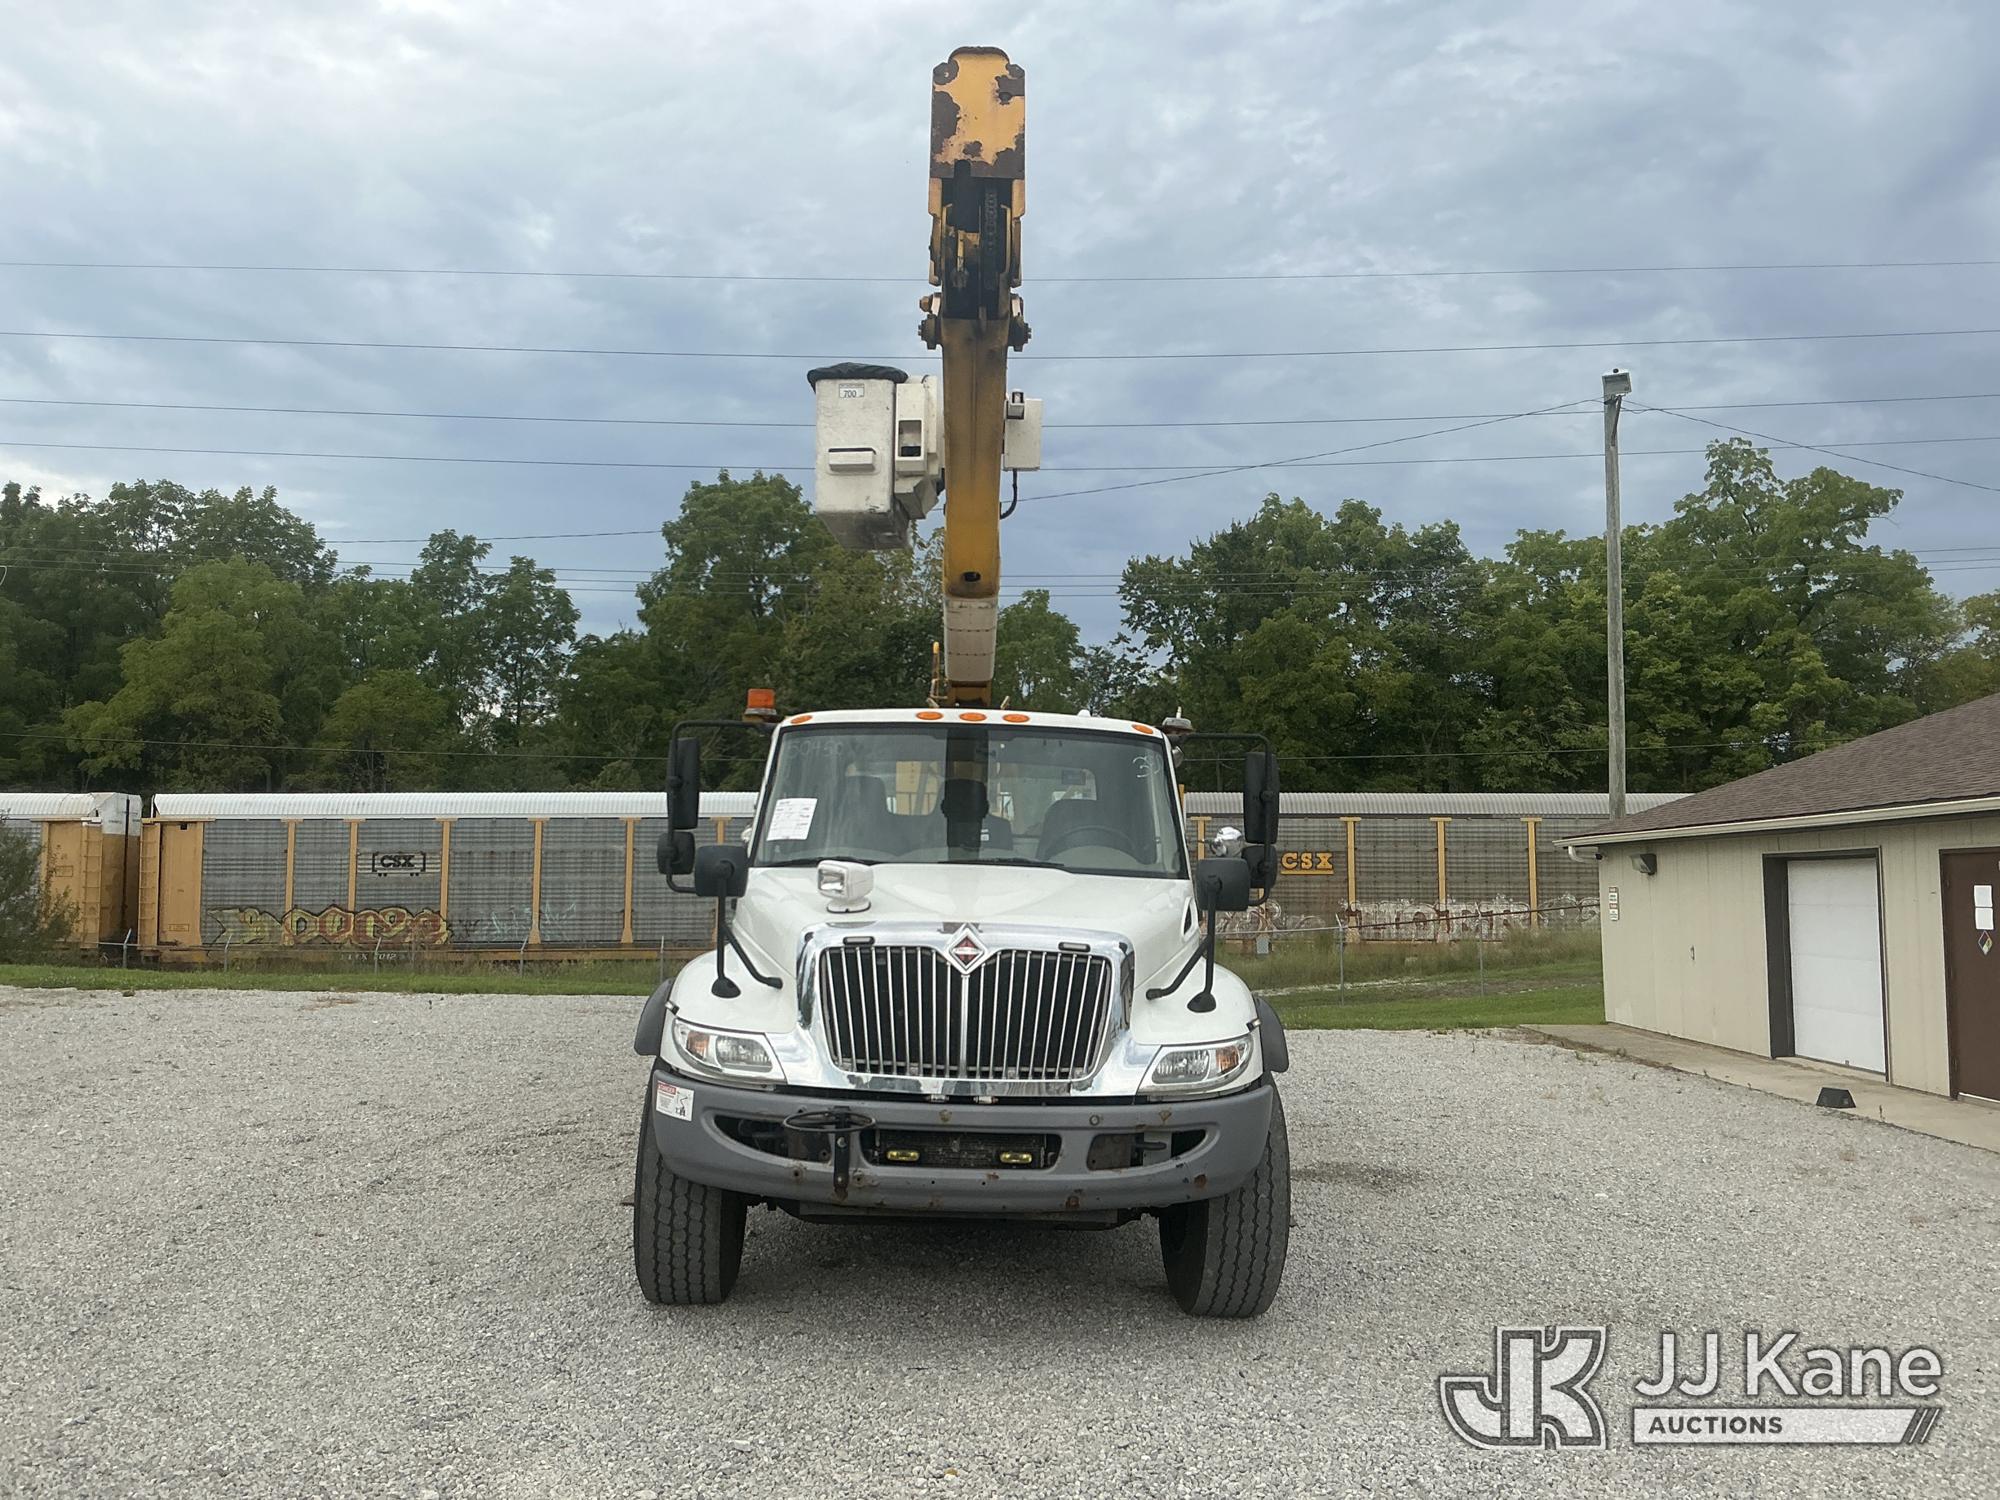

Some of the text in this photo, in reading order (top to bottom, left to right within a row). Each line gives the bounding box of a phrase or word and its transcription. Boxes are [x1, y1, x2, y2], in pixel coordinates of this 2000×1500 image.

[843, 389, 857, 398] 700
[380, 854, 416, 868] CSX
[1281, 851, 1334, 870] CSX
